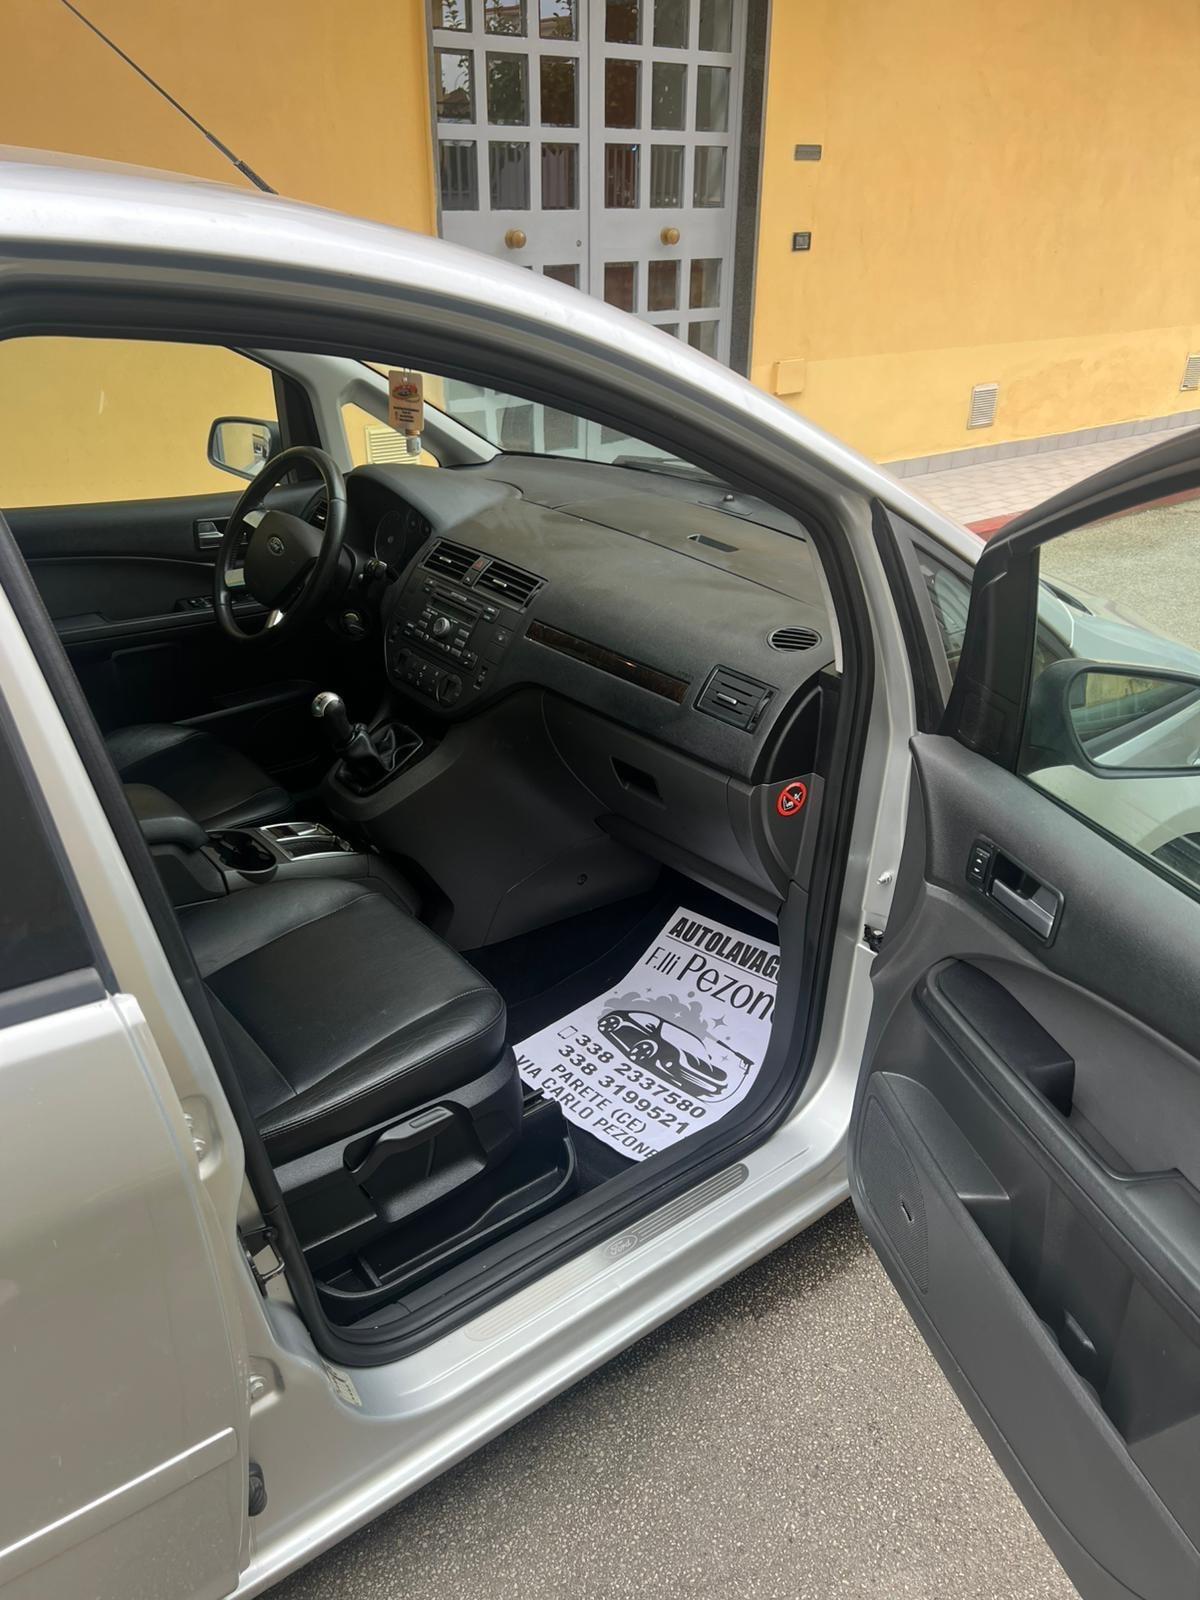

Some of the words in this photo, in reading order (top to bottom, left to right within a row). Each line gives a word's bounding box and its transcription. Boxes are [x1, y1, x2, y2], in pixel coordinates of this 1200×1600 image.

[668, 916, 780, 981] AUTOLAVAG
[645, 946, 681, 975] F.lli
[676, 953, 775, 1024] Pezon
[517, 1054, 543, 1079] VIA
[541, 1077, 594, 1119] CARLO
[551, 1064, 613, 1111] PARETE
[610, 1108, 647, 1134] (CE)
[558, 1045, 598, 1075] 338
[598, 1075, 690, 1134] 3199521
[575, 1034, 614, 1063] 338
[614, 1063, 706, 1118] 2337580
[610, 1239, 632, 1255] Ford
